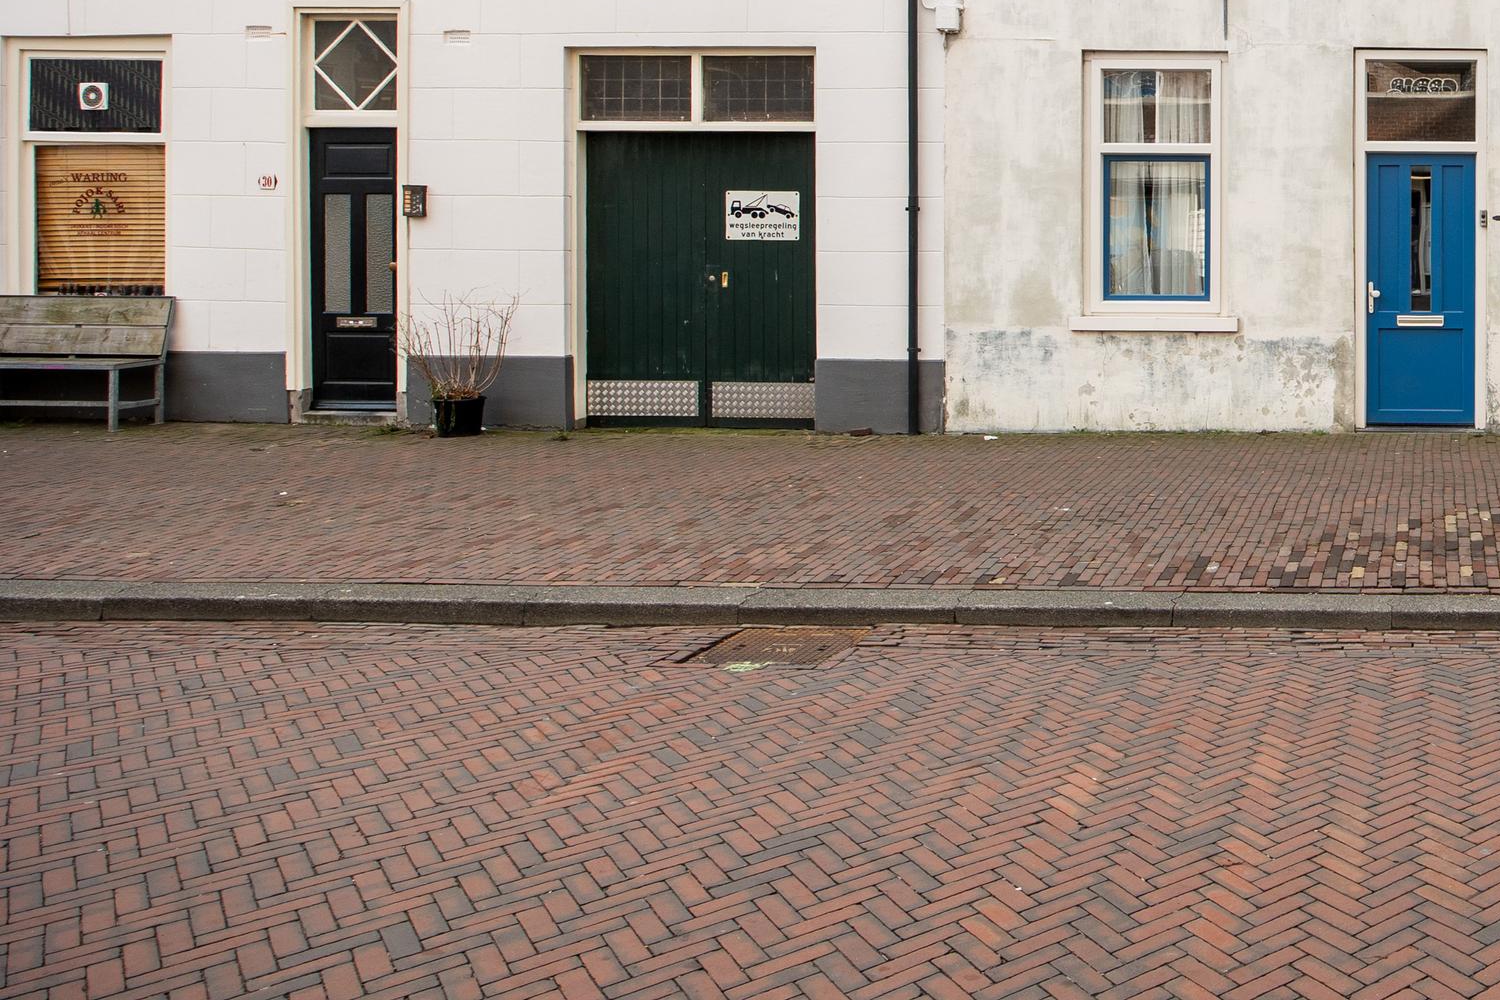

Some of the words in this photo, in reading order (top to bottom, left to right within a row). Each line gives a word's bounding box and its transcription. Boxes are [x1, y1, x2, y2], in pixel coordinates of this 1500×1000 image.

[71, 172, 127, 182] WARUNG
[261, 175, 273, 187] 30
[72, 187, 103, 215] POJOK
[729, 222, 797, 231] wegsleepregeling
